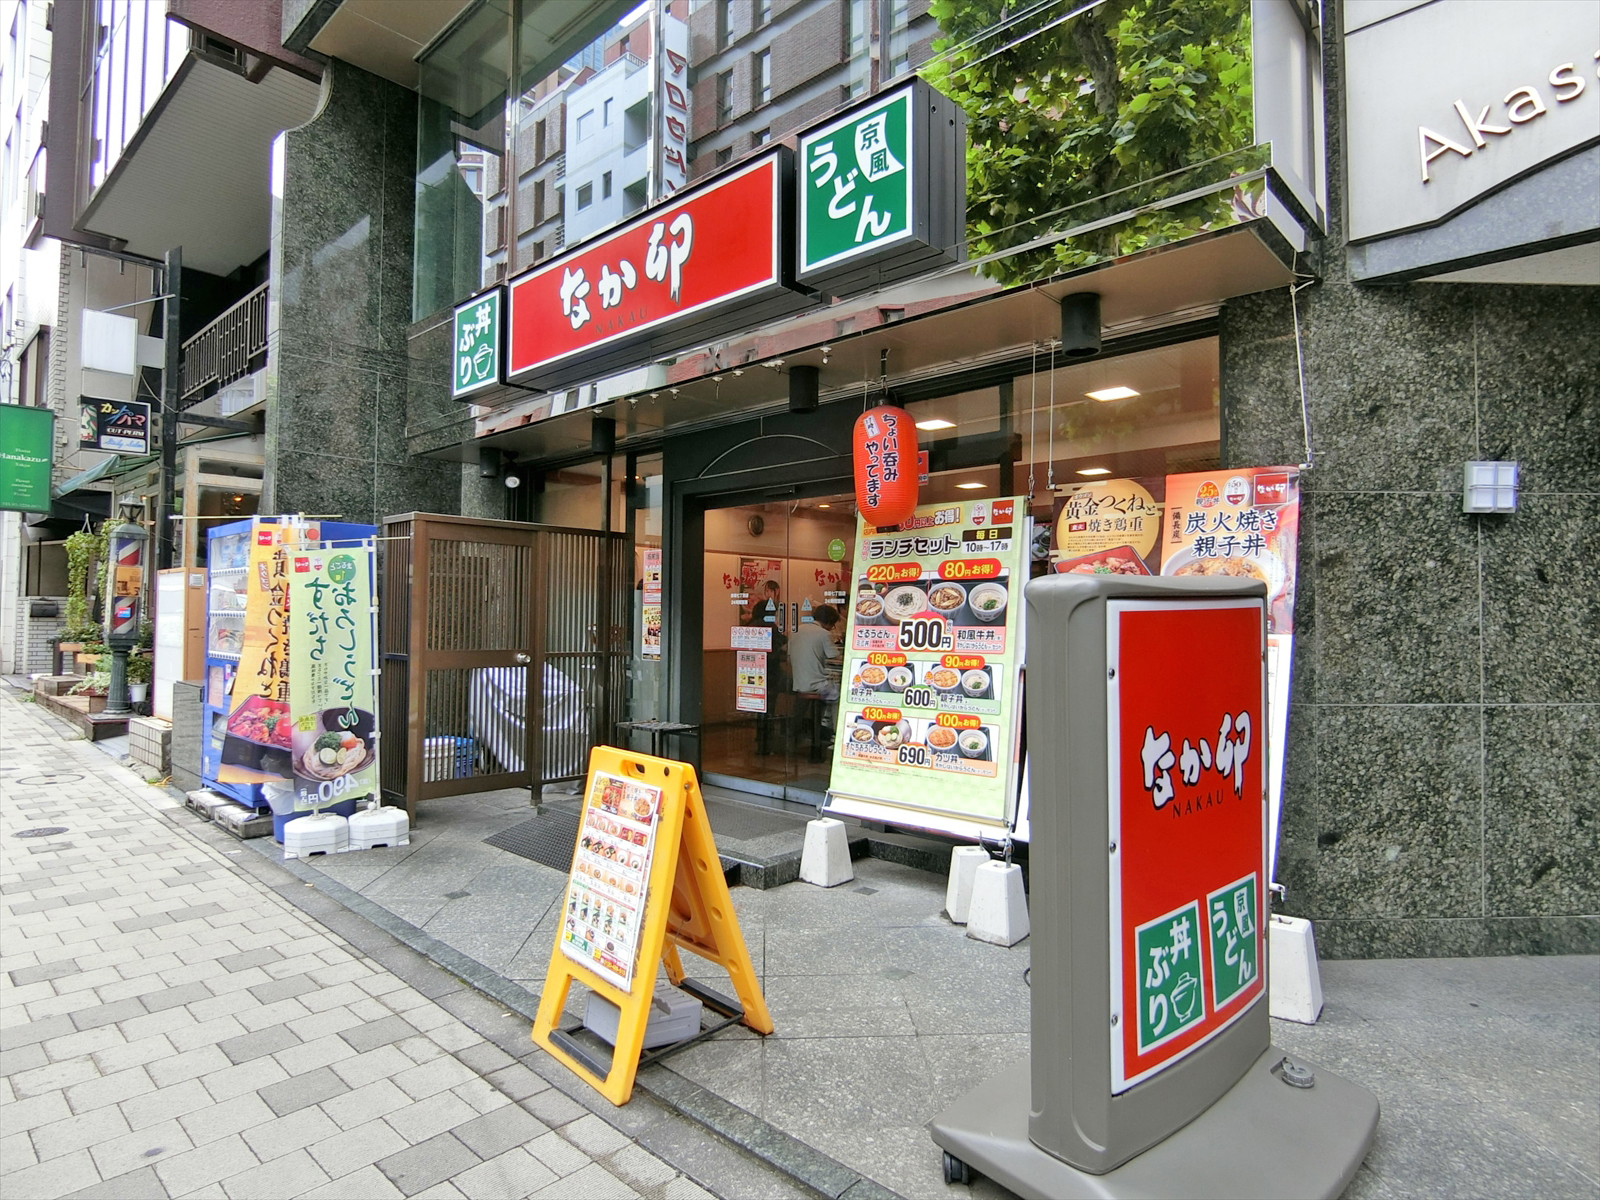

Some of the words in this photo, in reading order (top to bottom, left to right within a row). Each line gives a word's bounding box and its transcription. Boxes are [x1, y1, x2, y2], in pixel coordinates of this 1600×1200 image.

[1418, 49, 1600, 184] Akas
[860, 121, 889, 178] 京風
[809, 140, 892, 243] うどん
[559, 211, 694, 330] なか卯
[595, 306, 649, 334] NAKAU
[882, 413, 898, 482] ちょい呑み
[865, 441, 880, 508] やってます
[1256, 482, 1286, 495] なか卯
[1065, 493, 1156, 520] 黄金つくねと
[975, 529, 998, 540] 毎日
[1088, 515, 1143, 533] 焼き鶏重
[1184, 509, 1278, 534] 炭火焼き
[870, 533, 961, 559] ランチセット
[1191, 533, 1266, 558] 親子丼
[857, 628, 890, 639] ざるうどん
[900, 620, 951, 648] 500円
[957, 629, 995, 640] 和風牛丼
[904, 688, 936, 708] 600円
[898, 745, 931, 766] 690円
[1140, 709, 1252, 811] なか卯
[1172, 788, 1224, 819] NAKAU
[1212, 900, 1252, 986] うどん
